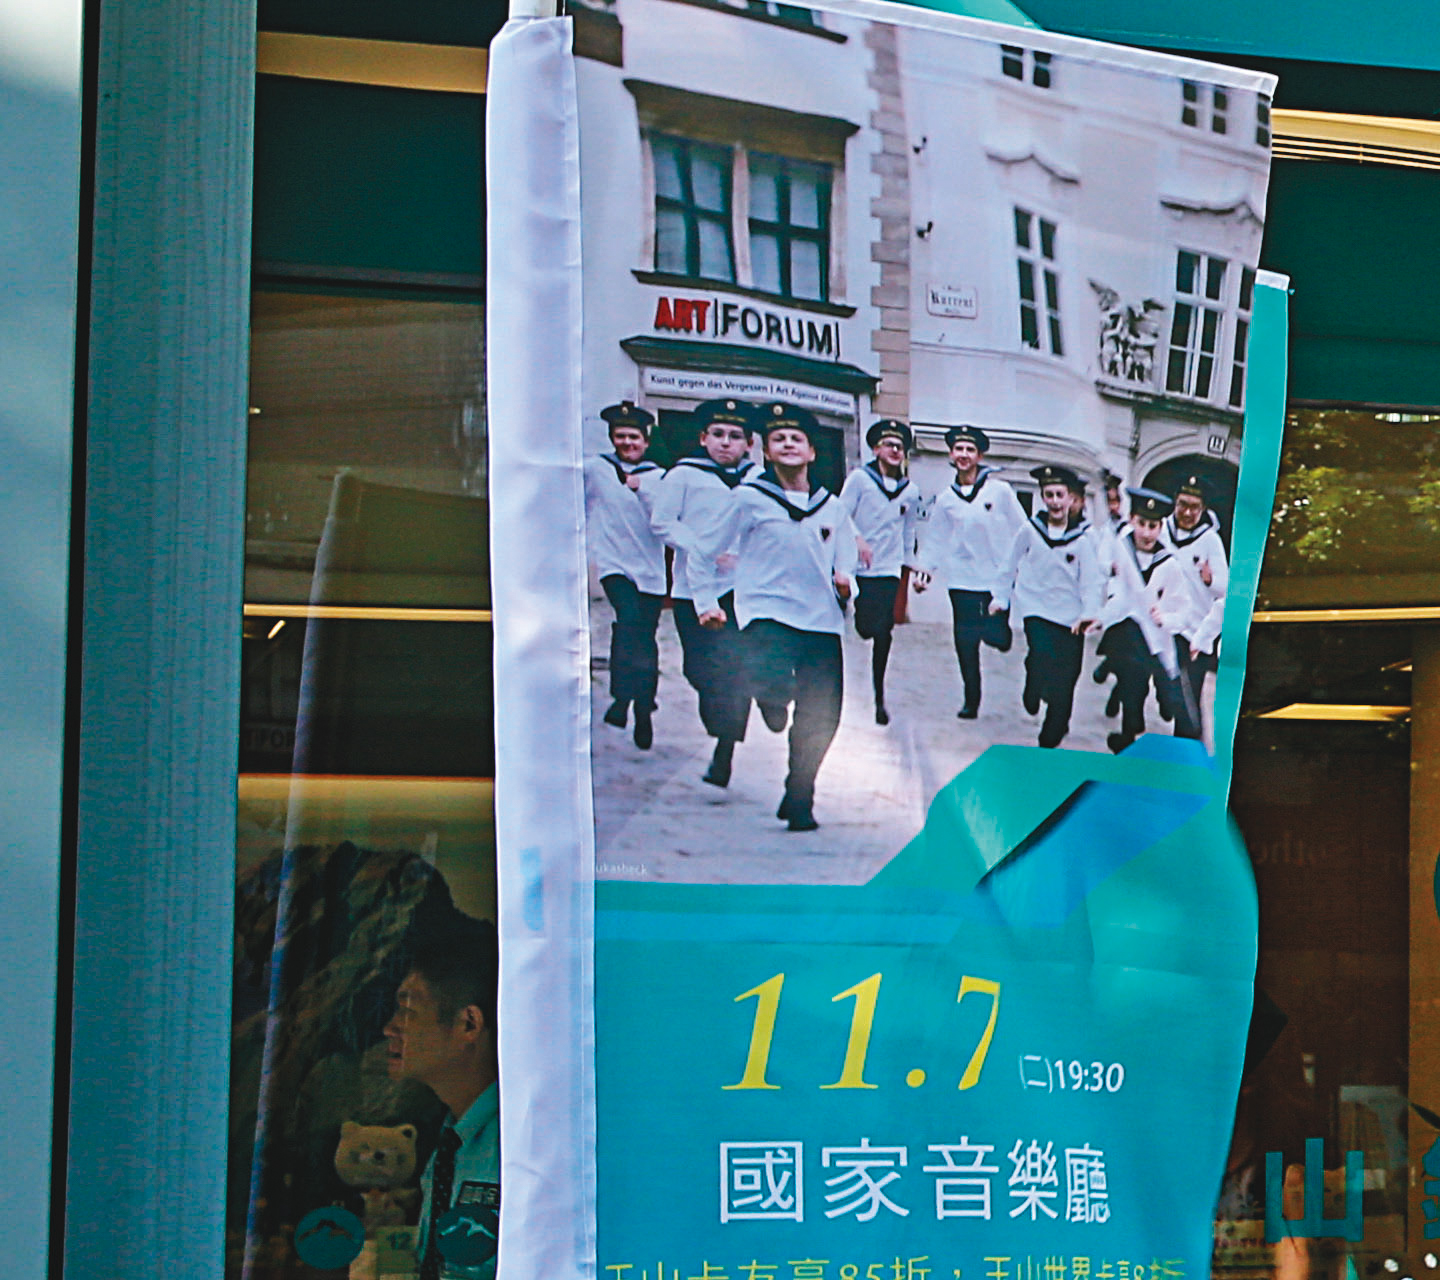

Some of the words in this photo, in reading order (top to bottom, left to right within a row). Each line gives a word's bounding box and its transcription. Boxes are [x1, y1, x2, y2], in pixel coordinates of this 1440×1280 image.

[721, 972, 1000, 1091] 11.7
[720, 1135, 1111, 1225] 國家音樂廳
